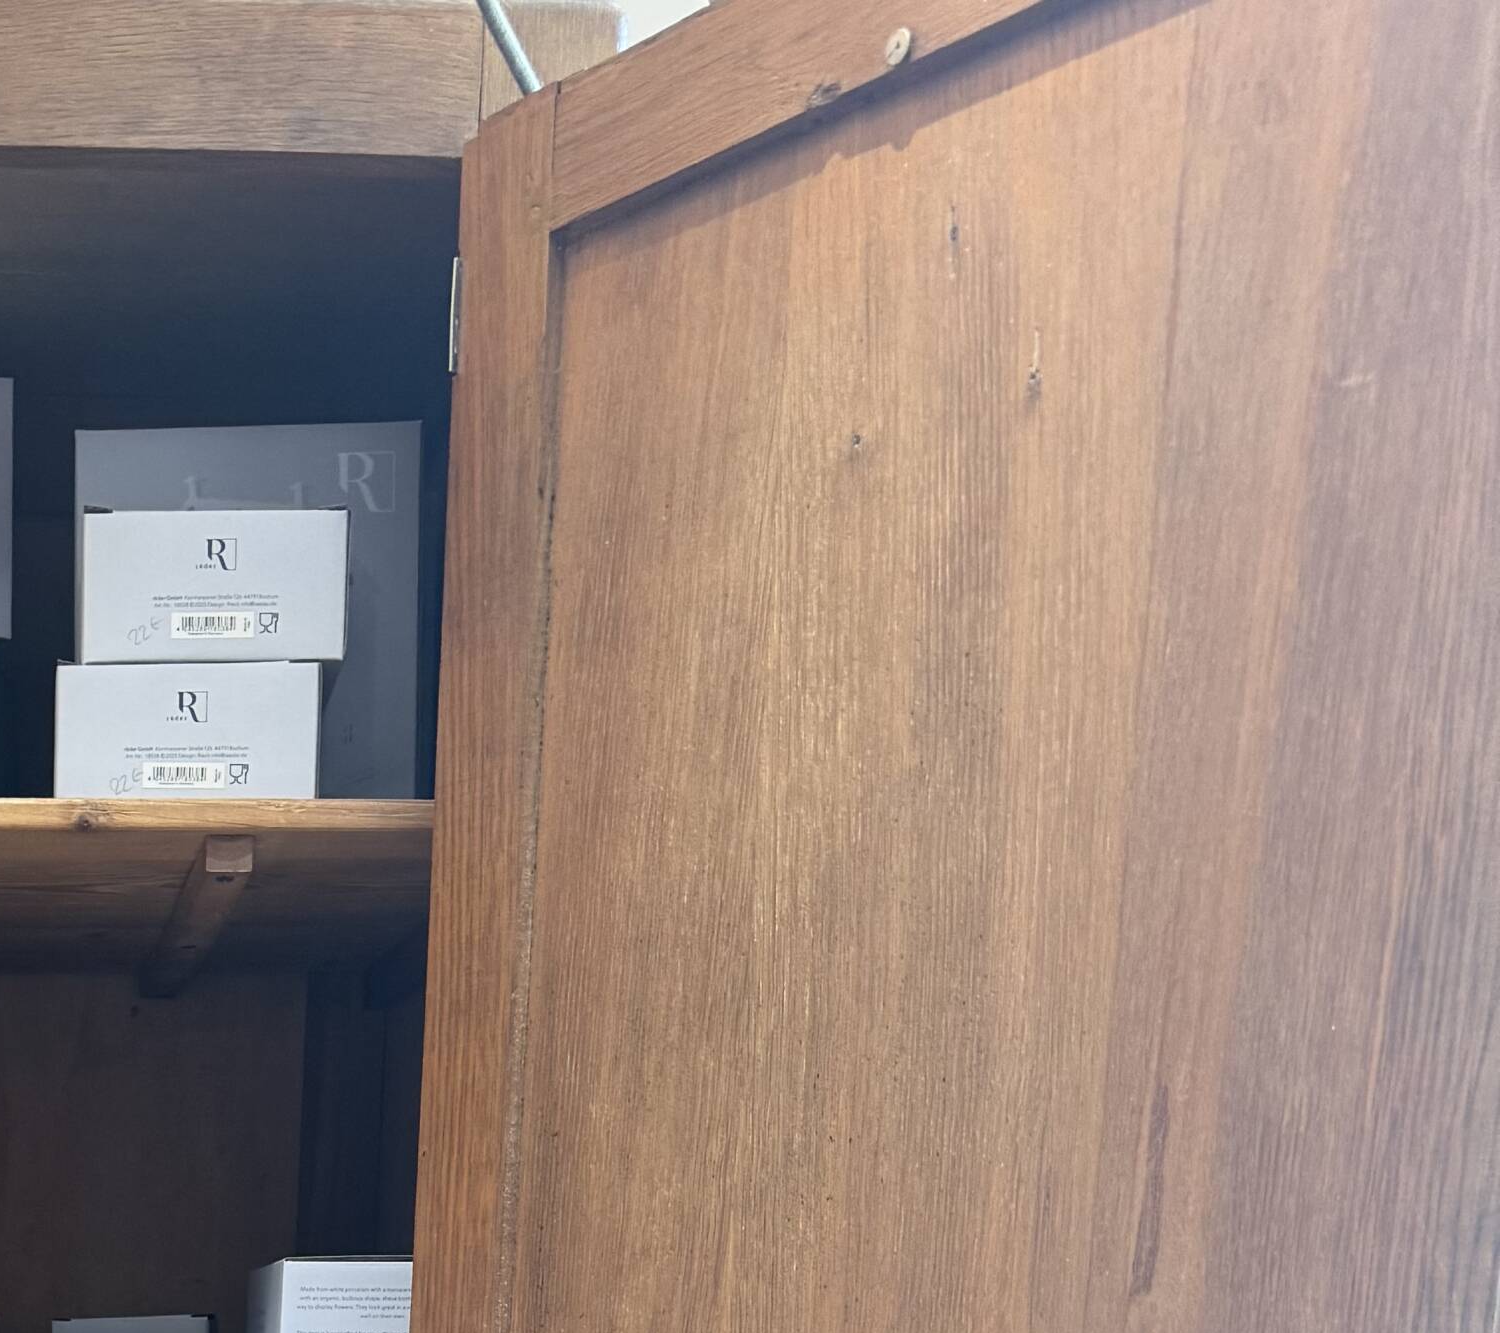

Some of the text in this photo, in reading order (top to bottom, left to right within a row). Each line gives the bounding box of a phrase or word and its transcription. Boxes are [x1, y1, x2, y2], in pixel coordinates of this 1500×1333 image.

[337, 452, 378, 512] R
[206, 538, 229, 571] R
[178, 691, 201, 723] R
